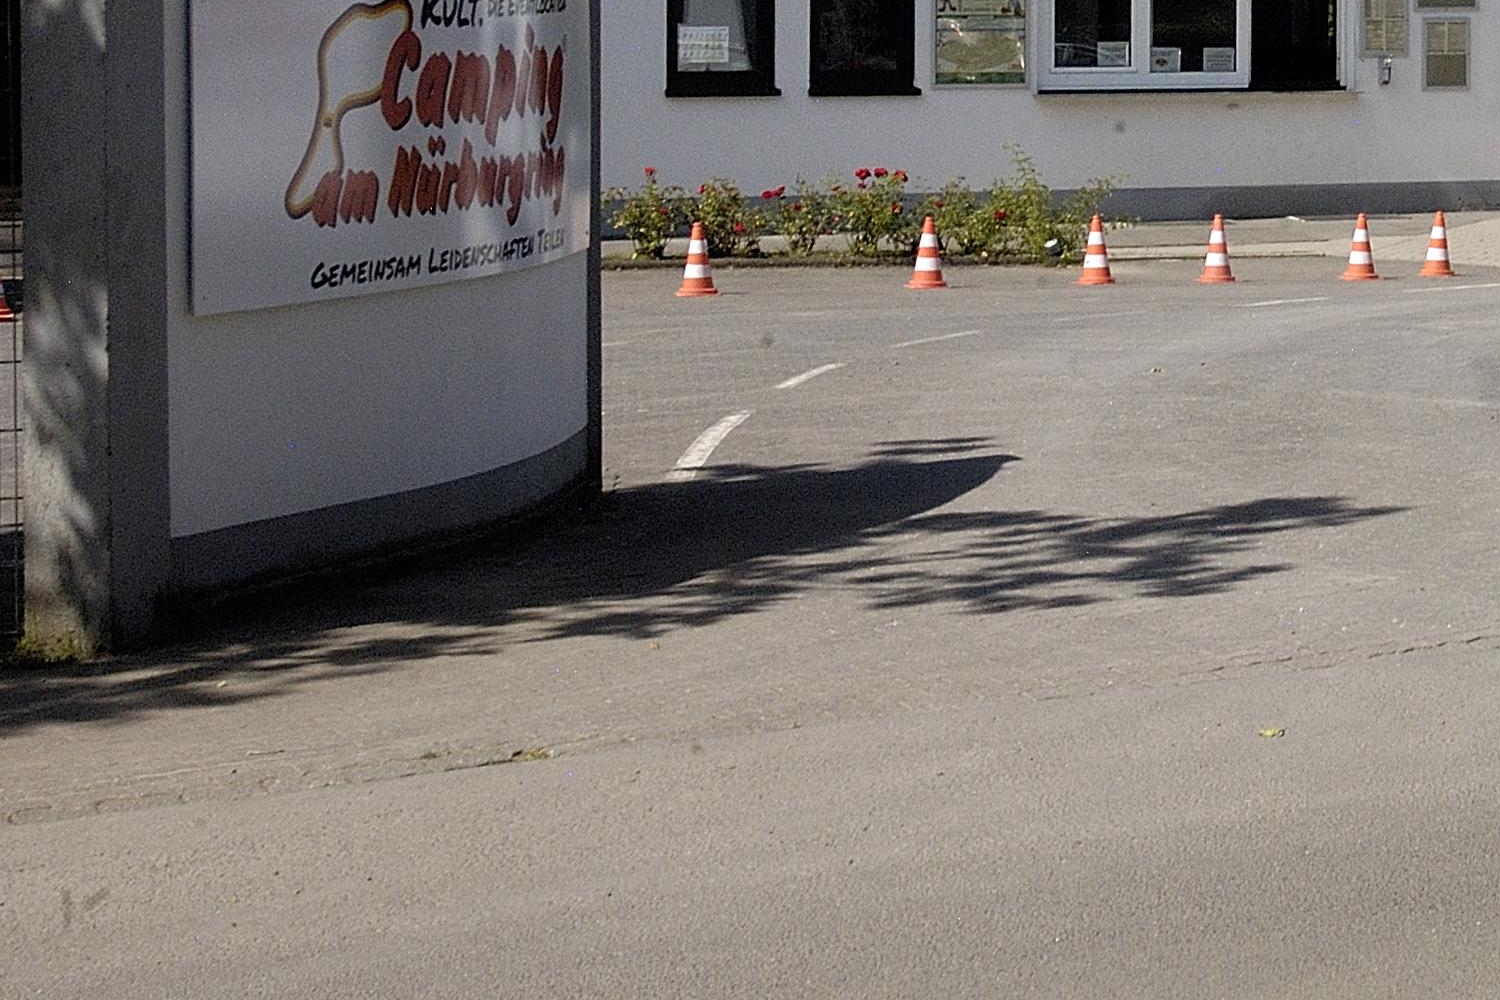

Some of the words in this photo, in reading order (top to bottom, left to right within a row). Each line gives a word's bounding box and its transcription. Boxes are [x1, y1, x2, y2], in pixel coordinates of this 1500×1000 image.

[381, 22, 564, 147] Camping
[312, 169, 380, 228] am
[387, 131, 565, 227] Nürburgring
[311, 252, 422, 290] GEMEINSAM
[427, 237, 535, 275] LEIDENSCHAFTEN
